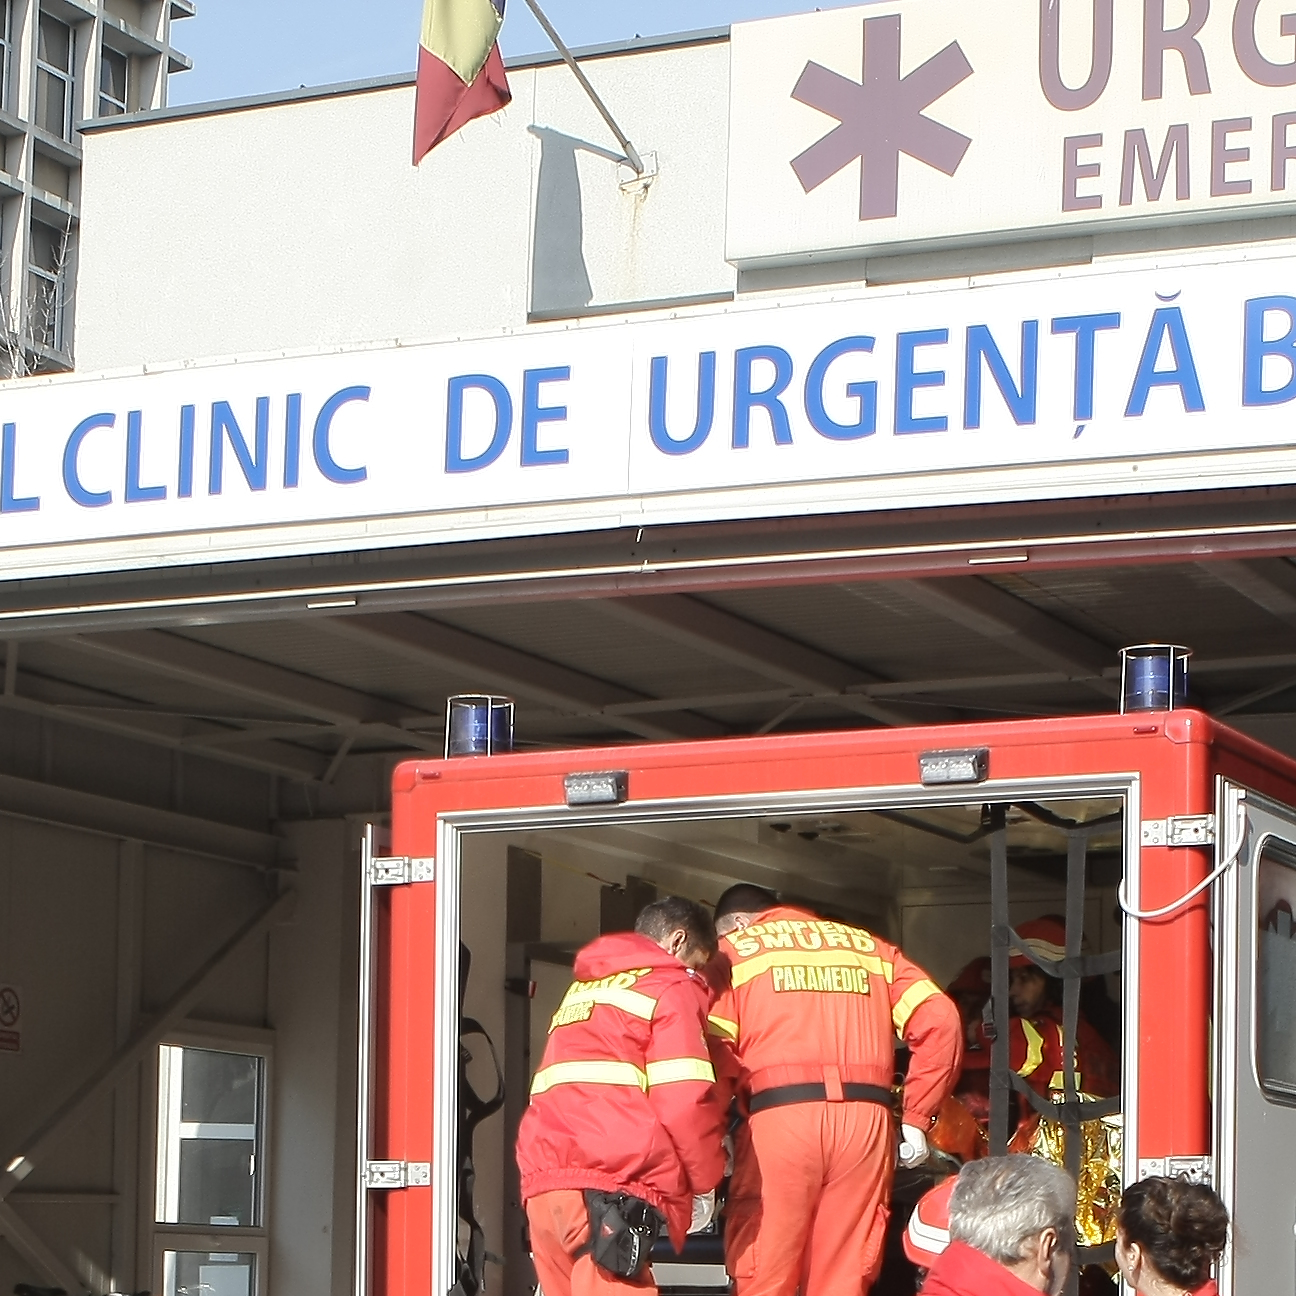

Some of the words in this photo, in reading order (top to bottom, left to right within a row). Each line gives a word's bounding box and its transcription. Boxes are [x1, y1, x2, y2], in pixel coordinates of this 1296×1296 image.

[61, 385, 372, 508] CLINIC
[443, 365, 572, 475] DE
[646, 290, 1206, 457] URGENȚĂ
[733, 931, 877, 957] SMURD
[772, 965, 870, 995] PARAMEDIC
